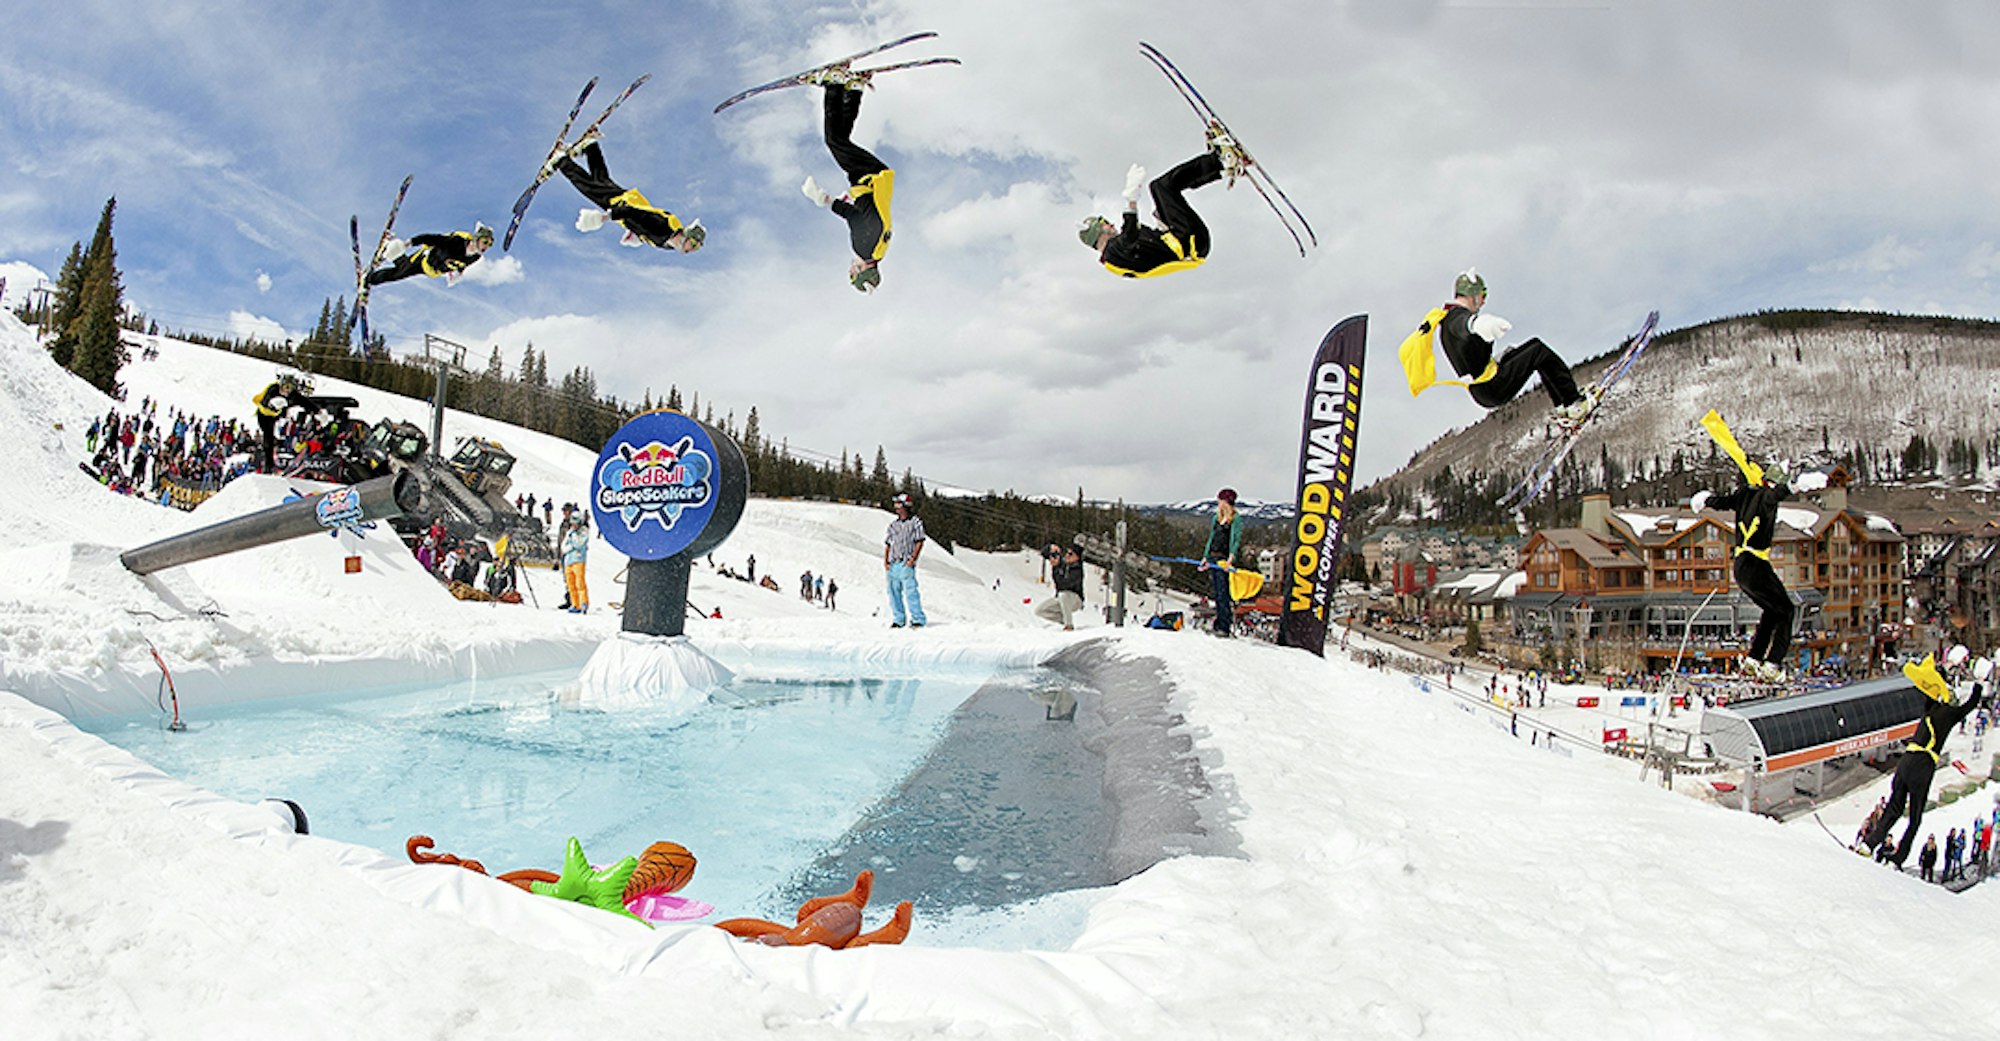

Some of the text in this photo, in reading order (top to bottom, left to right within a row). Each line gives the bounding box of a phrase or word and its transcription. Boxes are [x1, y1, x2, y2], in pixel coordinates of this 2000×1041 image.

[622, 466, 684, 485] Red Bull
[1289, 361, 1347, 612] WOODWARD
[1314, 518, 1339, 605] AT COPPER
